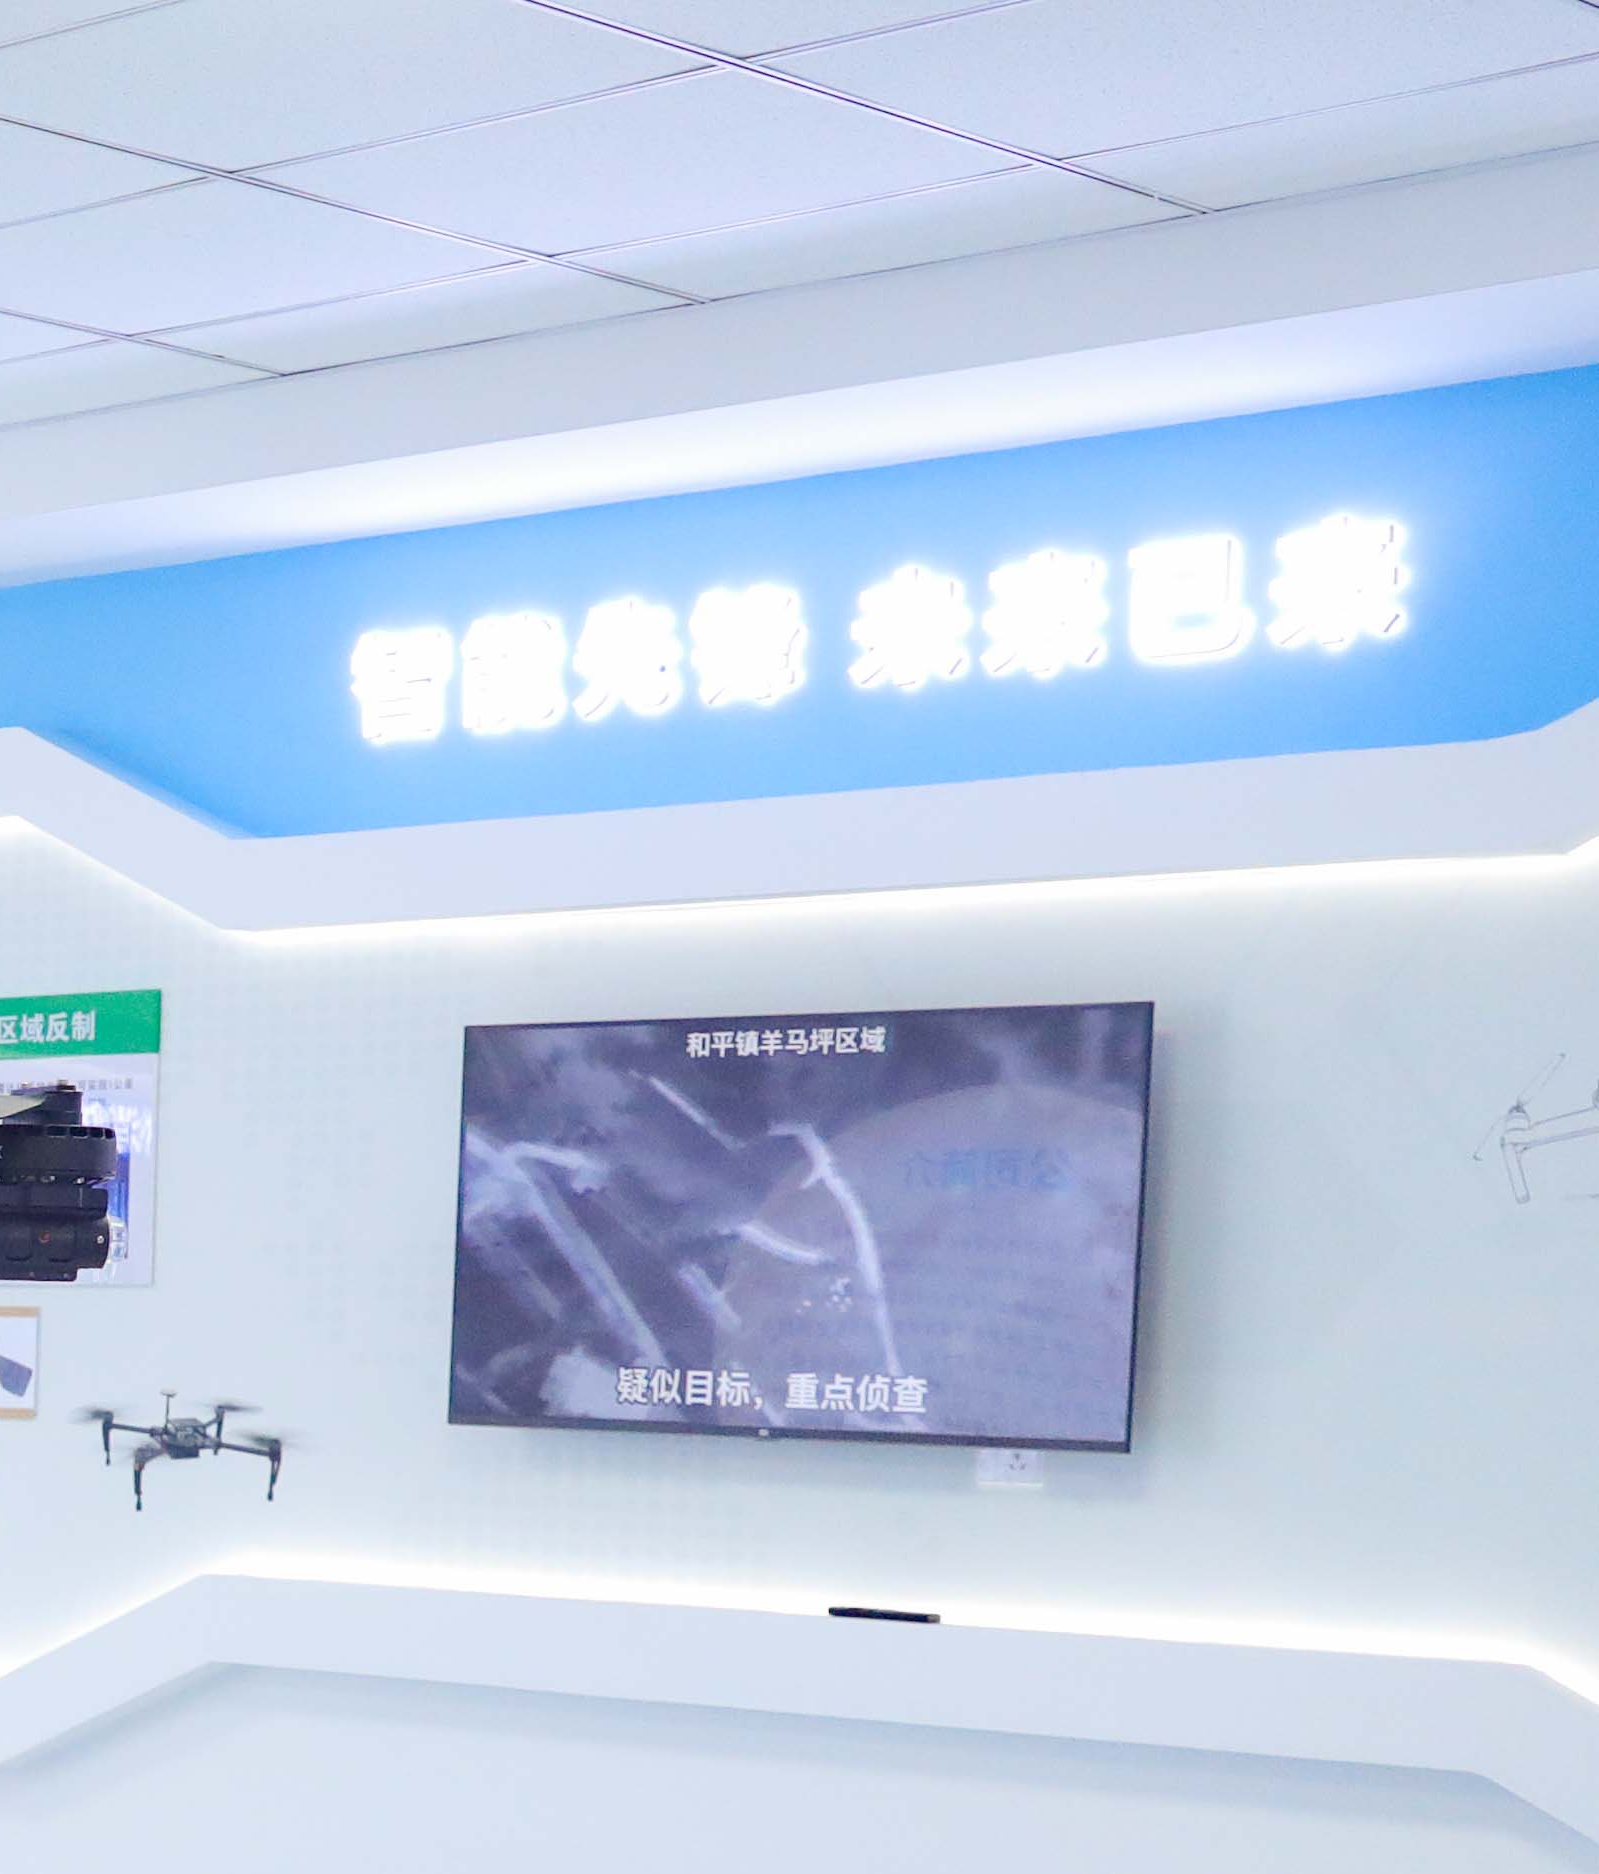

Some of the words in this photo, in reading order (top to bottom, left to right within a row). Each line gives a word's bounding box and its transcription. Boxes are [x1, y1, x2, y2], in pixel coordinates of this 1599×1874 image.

[847, 512, 1410, 692] 未来已来
[686, 1025, 887, 1058] 和平镇羊马坪区域
[616, 1366, 928, 1413] 疑似目标，重点侦查
